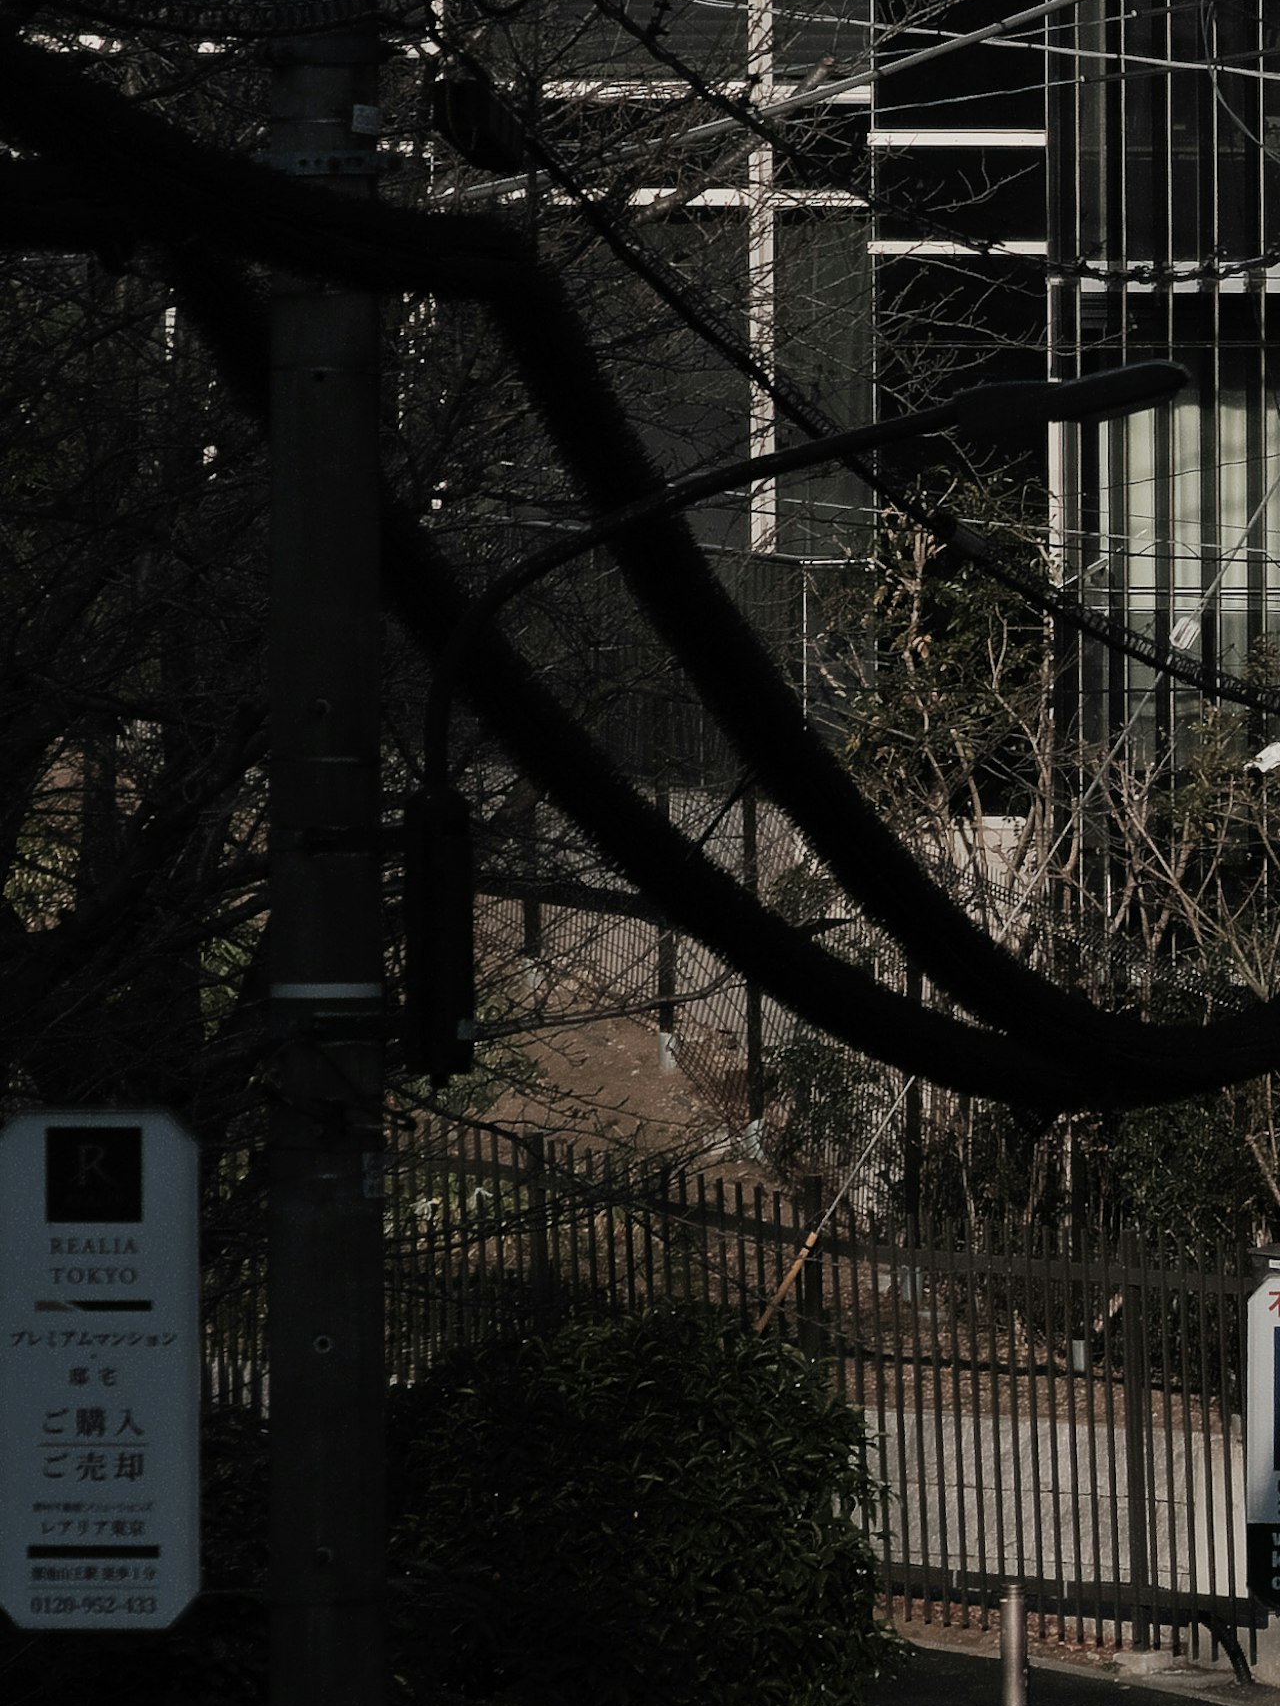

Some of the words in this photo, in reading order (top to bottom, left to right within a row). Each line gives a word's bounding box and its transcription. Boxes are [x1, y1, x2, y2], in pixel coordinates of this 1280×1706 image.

[50, 1238, 138, 1255] REALIA
[51, 1267, 137, 1285] TOKYO
[11, 1331, 177, 1347] プレミアムマンション
[42, 1408, 145, 1437] ご購入
[42, 1451, 146, 1482] ご売却
